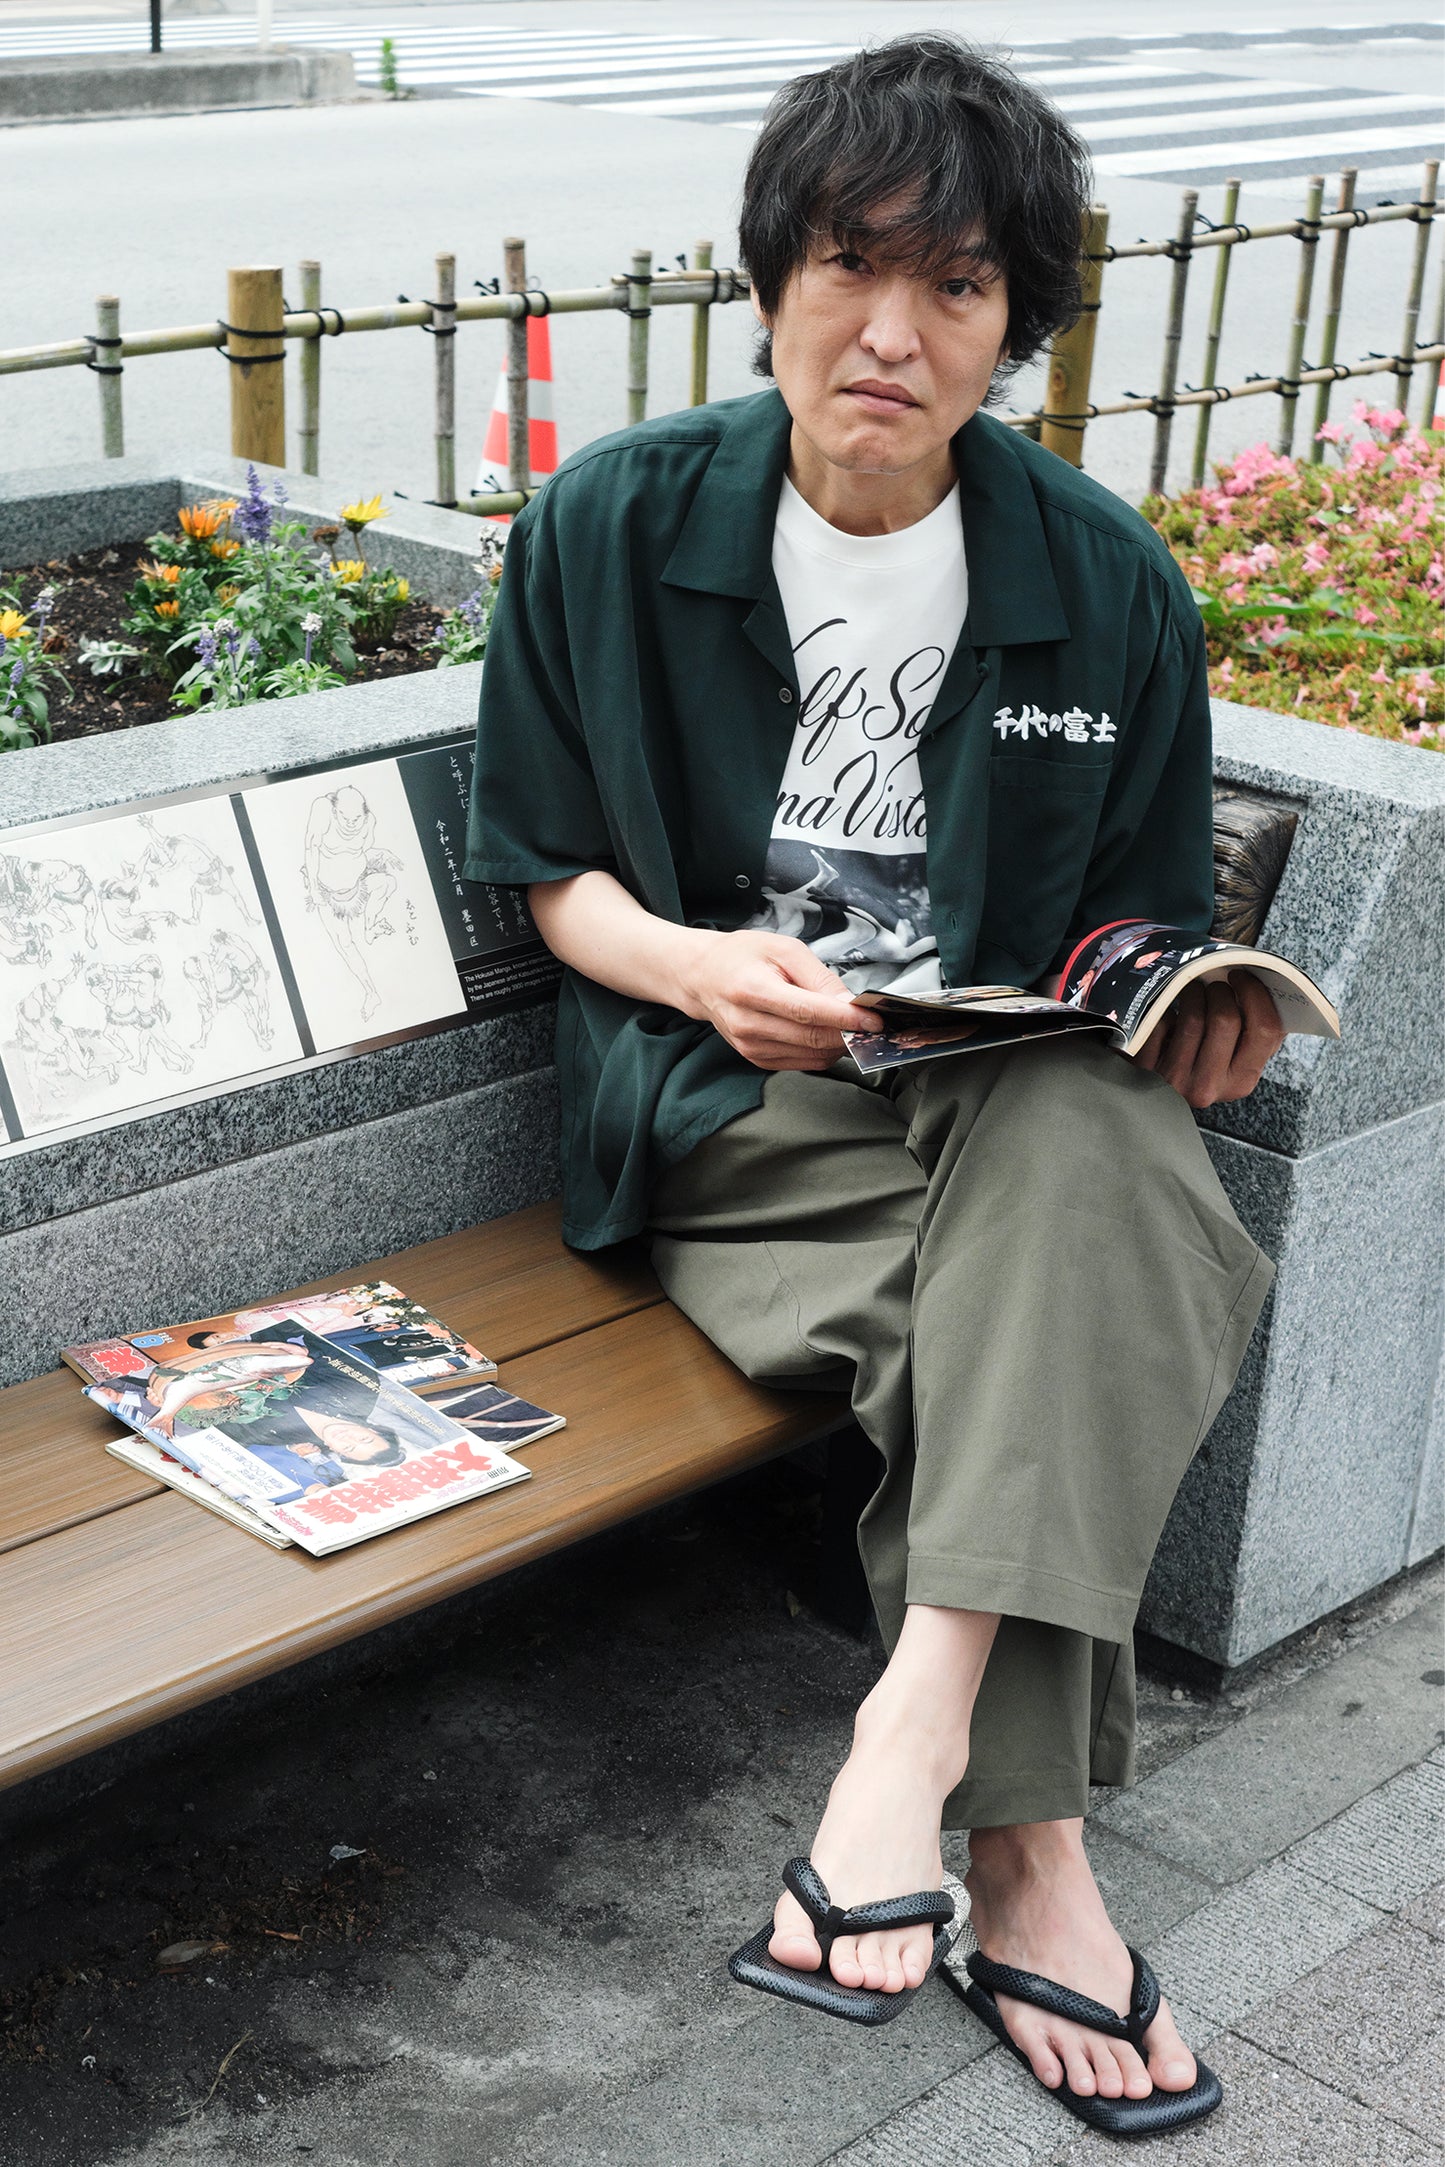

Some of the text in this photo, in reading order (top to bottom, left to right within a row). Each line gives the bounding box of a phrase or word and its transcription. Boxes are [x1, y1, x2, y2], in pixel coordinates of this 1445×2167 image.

[993, 704, 1117, 743] 千代の富士
[436, 819, 478, 947] 令和二年三月 墨田区
[483, 978, 506, 988] Japanese
[131, 1334, 165, 1348] 8
[293, 1441, 493, 1526] 大相撲特集
